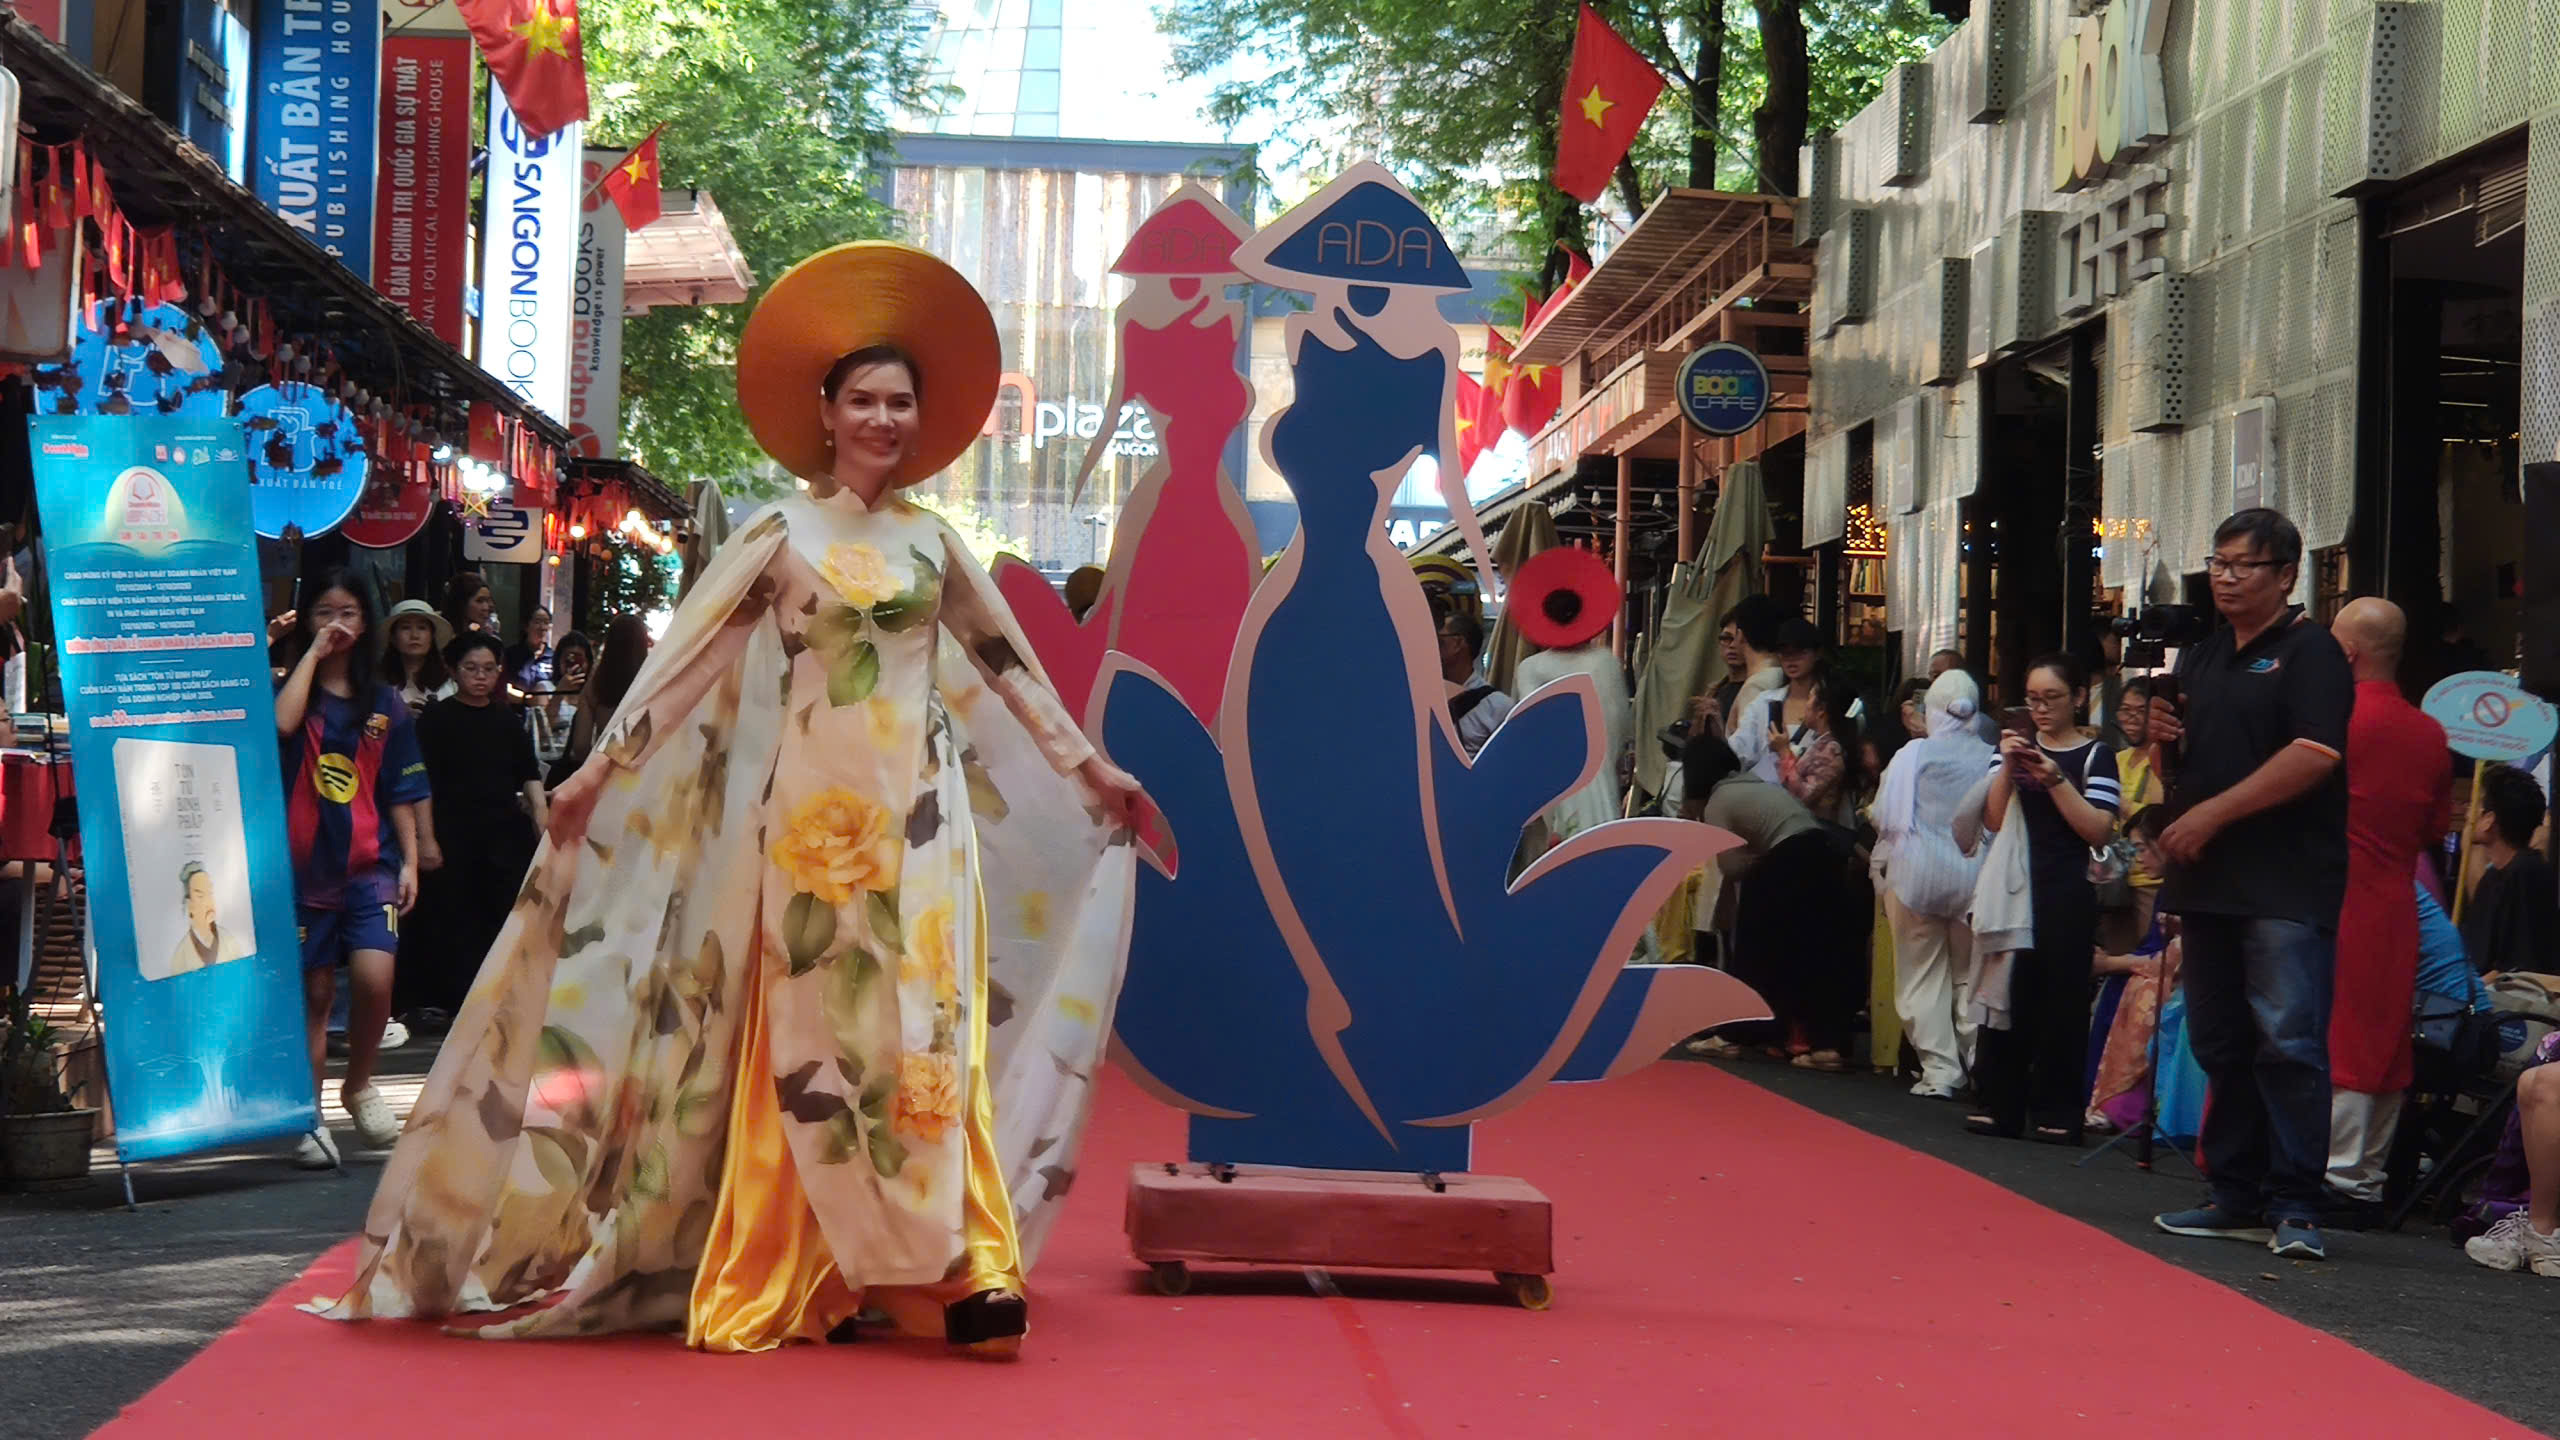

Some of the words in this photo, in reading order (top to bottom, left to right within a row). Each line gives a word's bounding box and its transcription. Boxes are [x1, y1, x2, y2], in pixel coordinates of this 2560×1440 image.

[269, 47, 321, 127] BẢN
[428, 59, 444, 112] HOUSE
[2054, 0, 2169, 193] BOOK
[394, 120, 416, 144] GIA
[265, 138, 319, 233] XUẤT
[325, 77, 350, 257] PUBLISHING
[387, 148, 415, 188] QUỐC
[425, 116, 442, 208] PUBLISHING
[388, 217, 413, 262] CHÍNH
[423, 213, 439, 291] POLITICAL
[1141, 227, 1228, 265] ADA
[1317, 220, 1433, 269] ADA
[593, 247, 606, 286] power
[593, 290, 603, 300] is
[589, 304, 604, 371] knowledge
[1693, 376, 1757, 395] BOOK
[1693, 396, 1756, 410] CAFE
